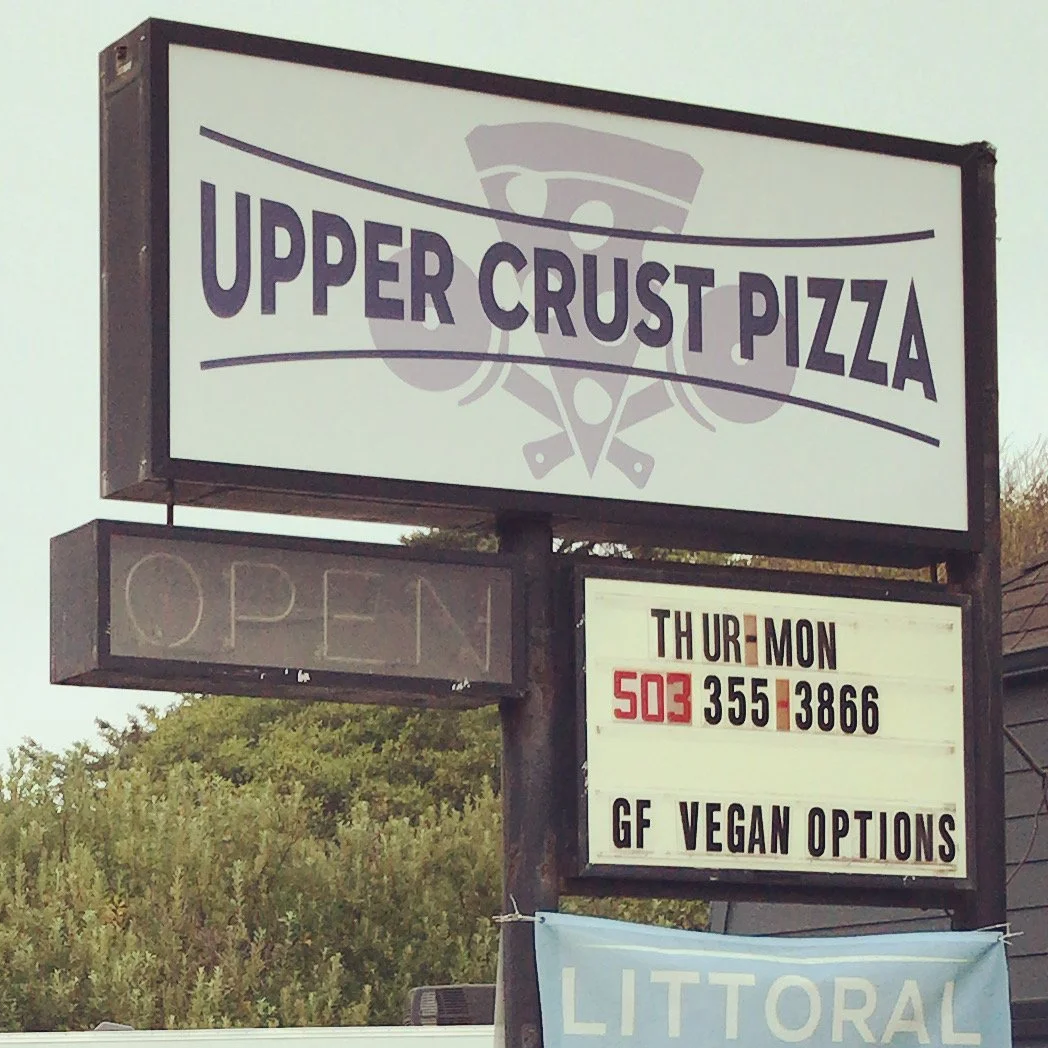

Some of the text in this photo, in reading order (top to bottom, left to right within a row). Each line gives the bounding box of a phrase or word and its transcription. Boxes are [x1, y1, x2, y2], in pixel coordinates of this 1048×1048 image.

[200, 181, 938, 402] UPPER CRUST PIZZA
[125, 552, 492, 673] OPEN
[613, 670, 692, 723] 503
[612, 797, 956, 863] GF VEGAN OPTIONS
[561, 967, 982, 1046] LITTORAL
